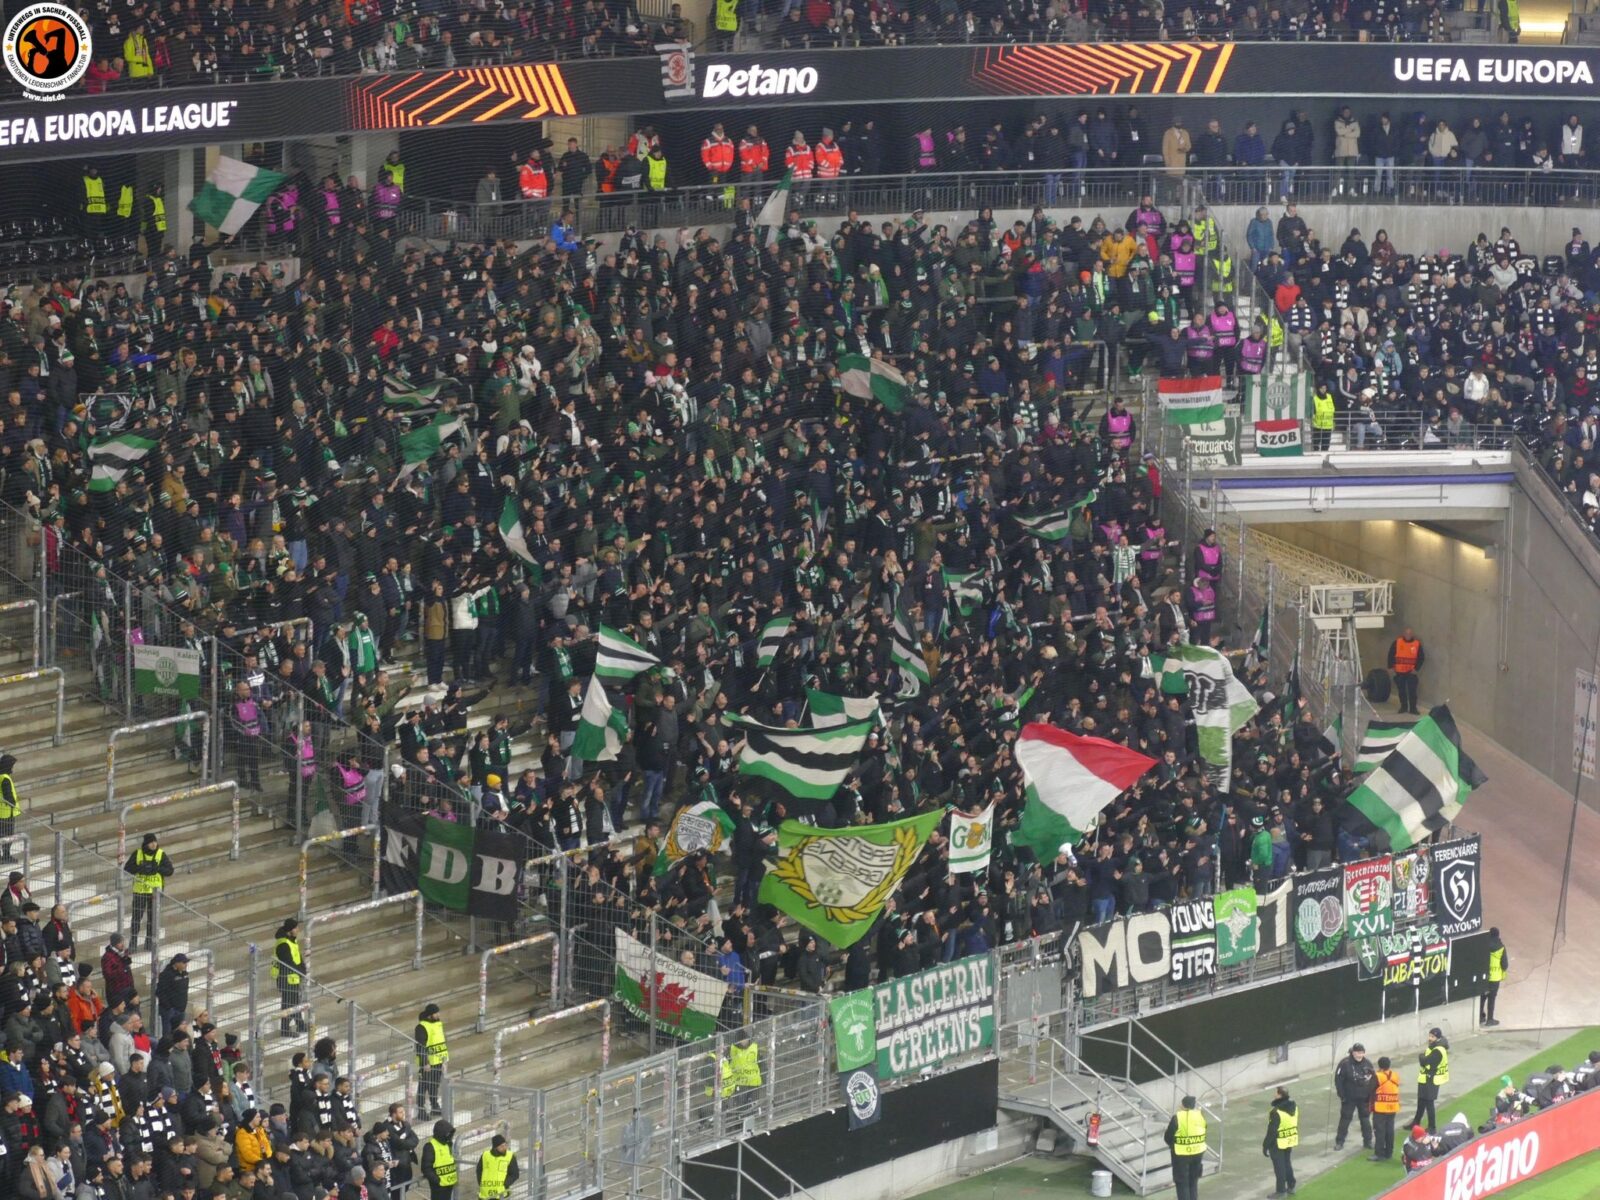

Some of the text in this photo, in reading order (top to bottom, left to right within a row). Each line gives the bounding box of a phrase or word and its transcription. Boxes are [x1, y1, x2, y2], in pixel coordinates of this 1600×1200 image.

[702, 64, 818, 98] Betano
[1394, 57, 1594, 84] UEFA EUROPA
[44, 109, 136, 142] EUROPA
[1260, 431, 1297, 446] SZOB
[1171, 901, 1215, 934] YOUNG
[1352, 913, 1390, 937] XVI.
[876, 959, 992, 1033] EASTERN
[889, 1007, 981, 1073] GREENS
[1444, 1130, 1539, 1200] Betano
